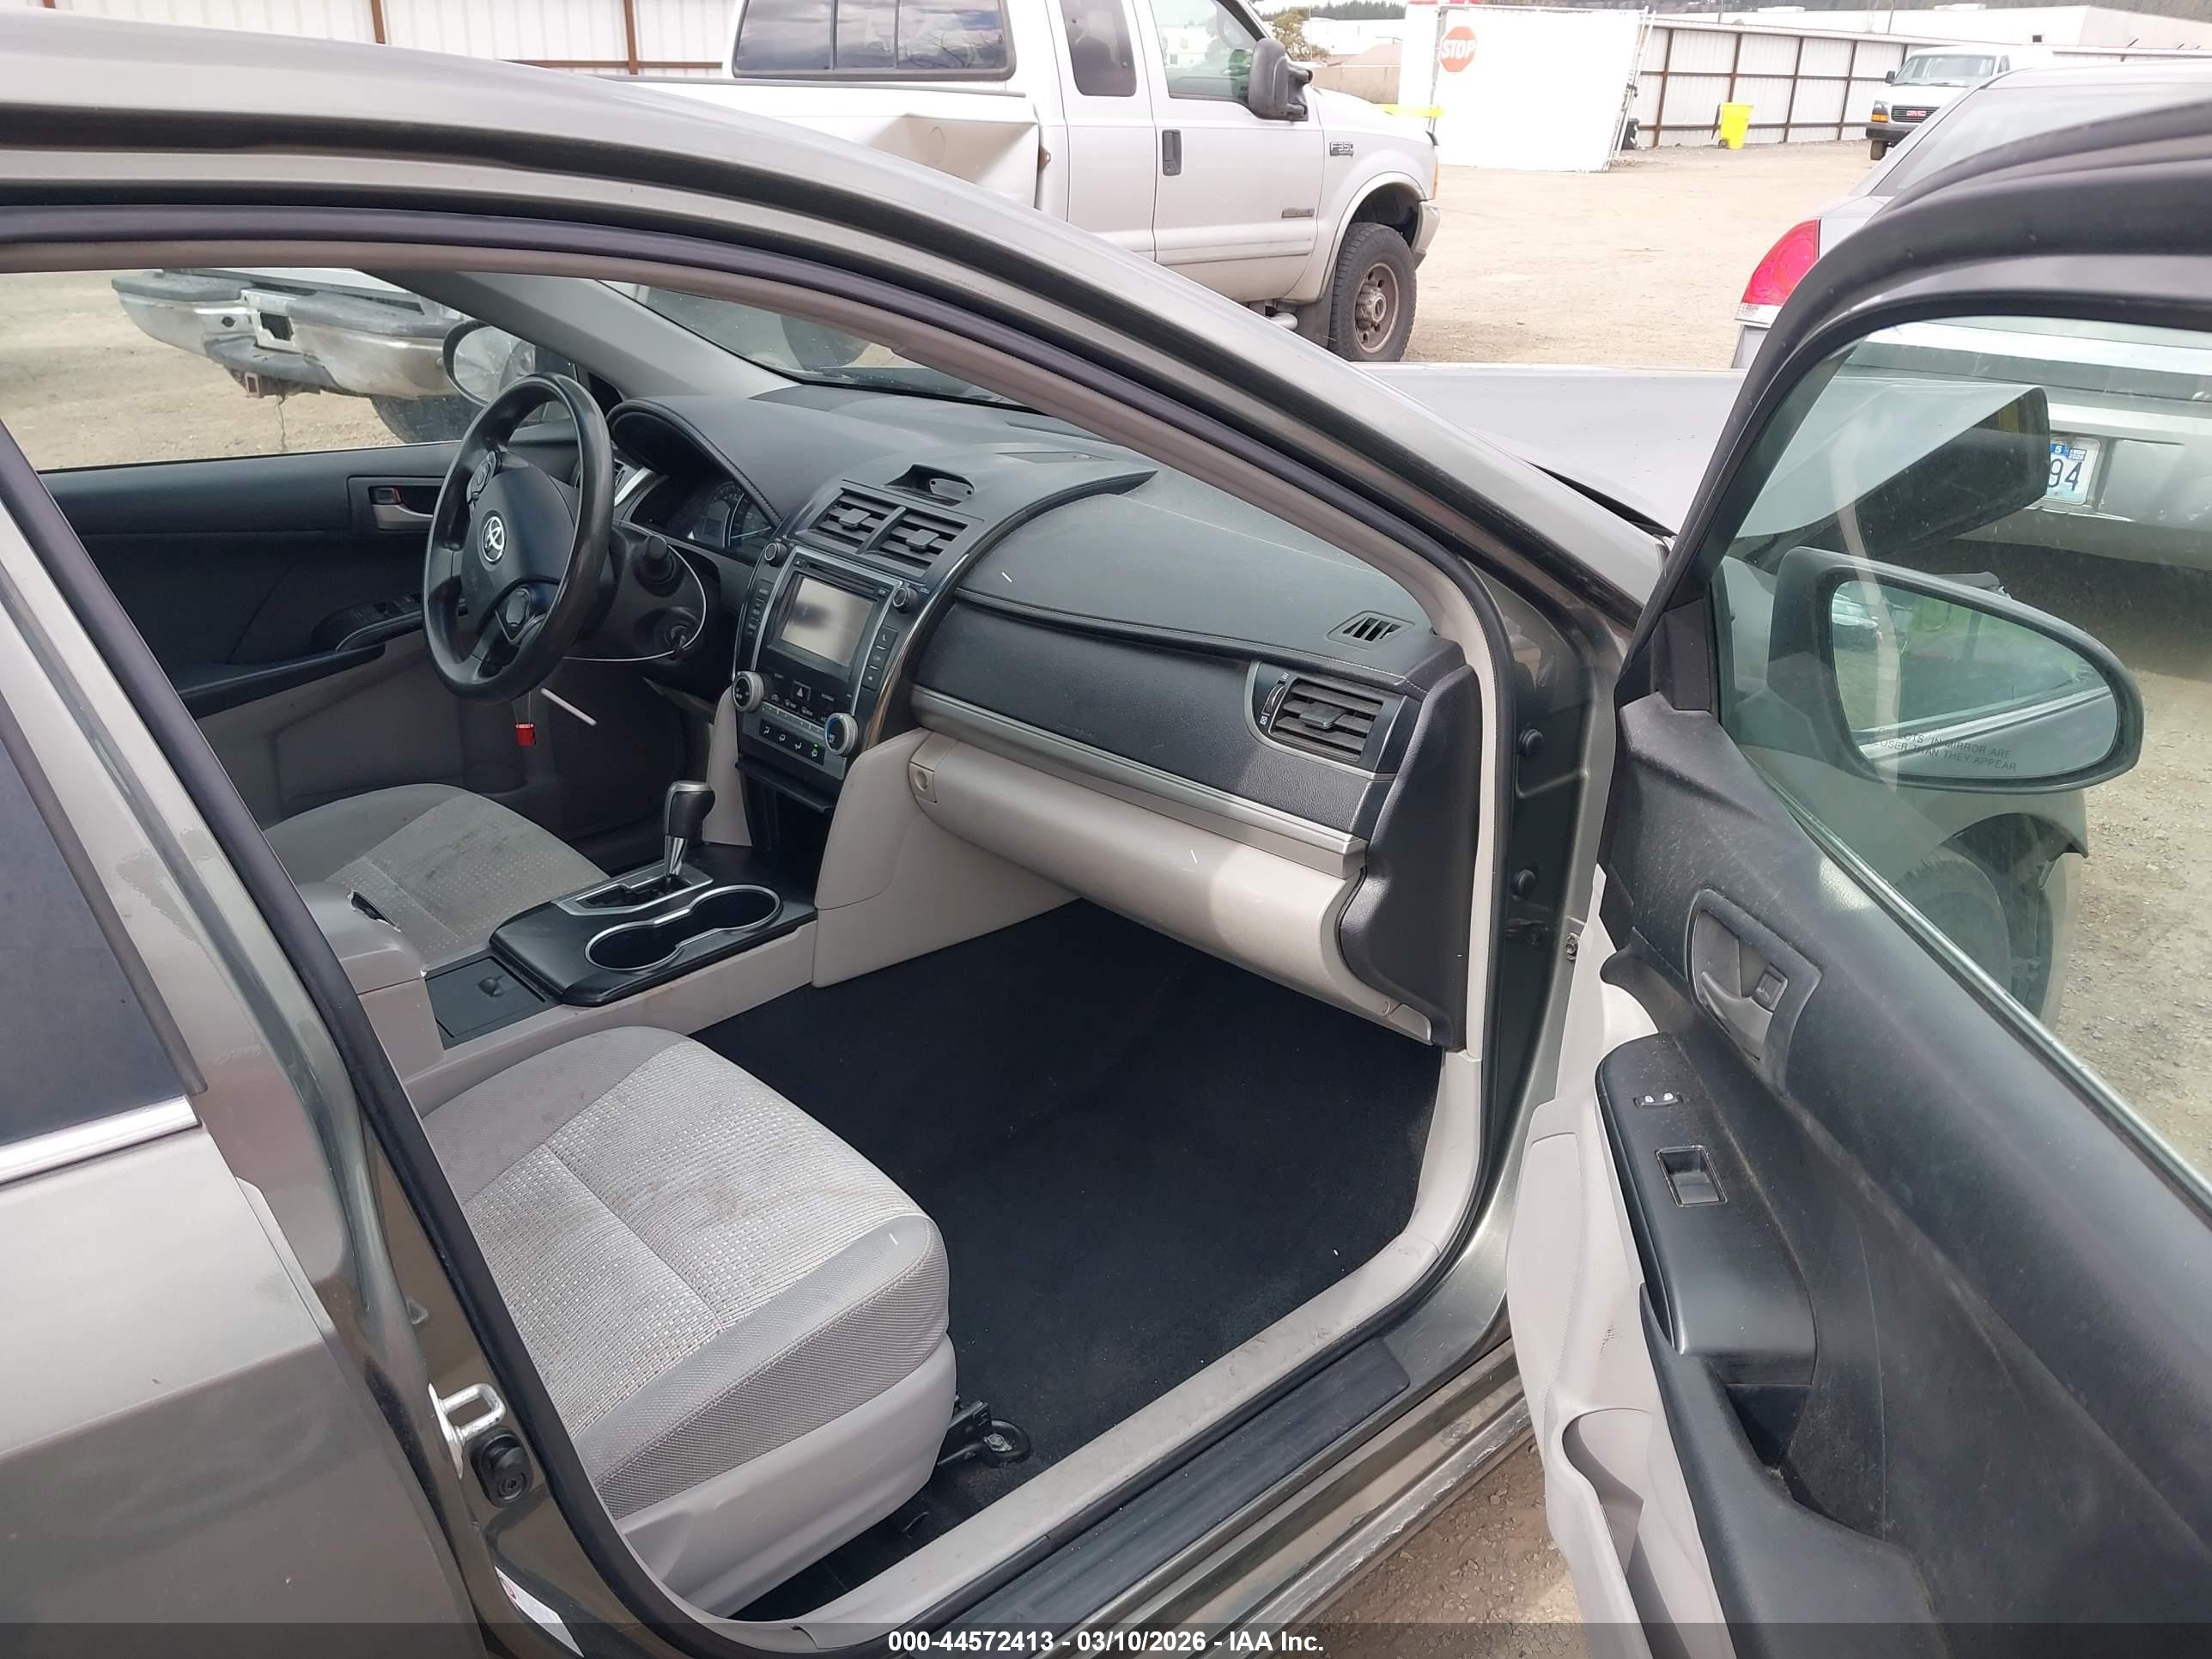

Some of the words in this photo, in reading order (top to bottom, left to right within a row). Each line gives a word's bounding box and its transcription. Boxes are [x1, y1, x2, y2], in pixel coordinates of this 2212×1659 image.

[1441, 40, 1476, 59] STOP
[2055, 445, 2063, 454] 5
[2048, 459, 2083, 491] 94
[1913, 744, 1939, 757] TAN
[1944, 750, 1971, 763] THEY
[1973, 757, 2018, 771] APPEAR
[1944, 741, 1985, 755] MIRROR
[1990, 748, 2013, 759] ARE
